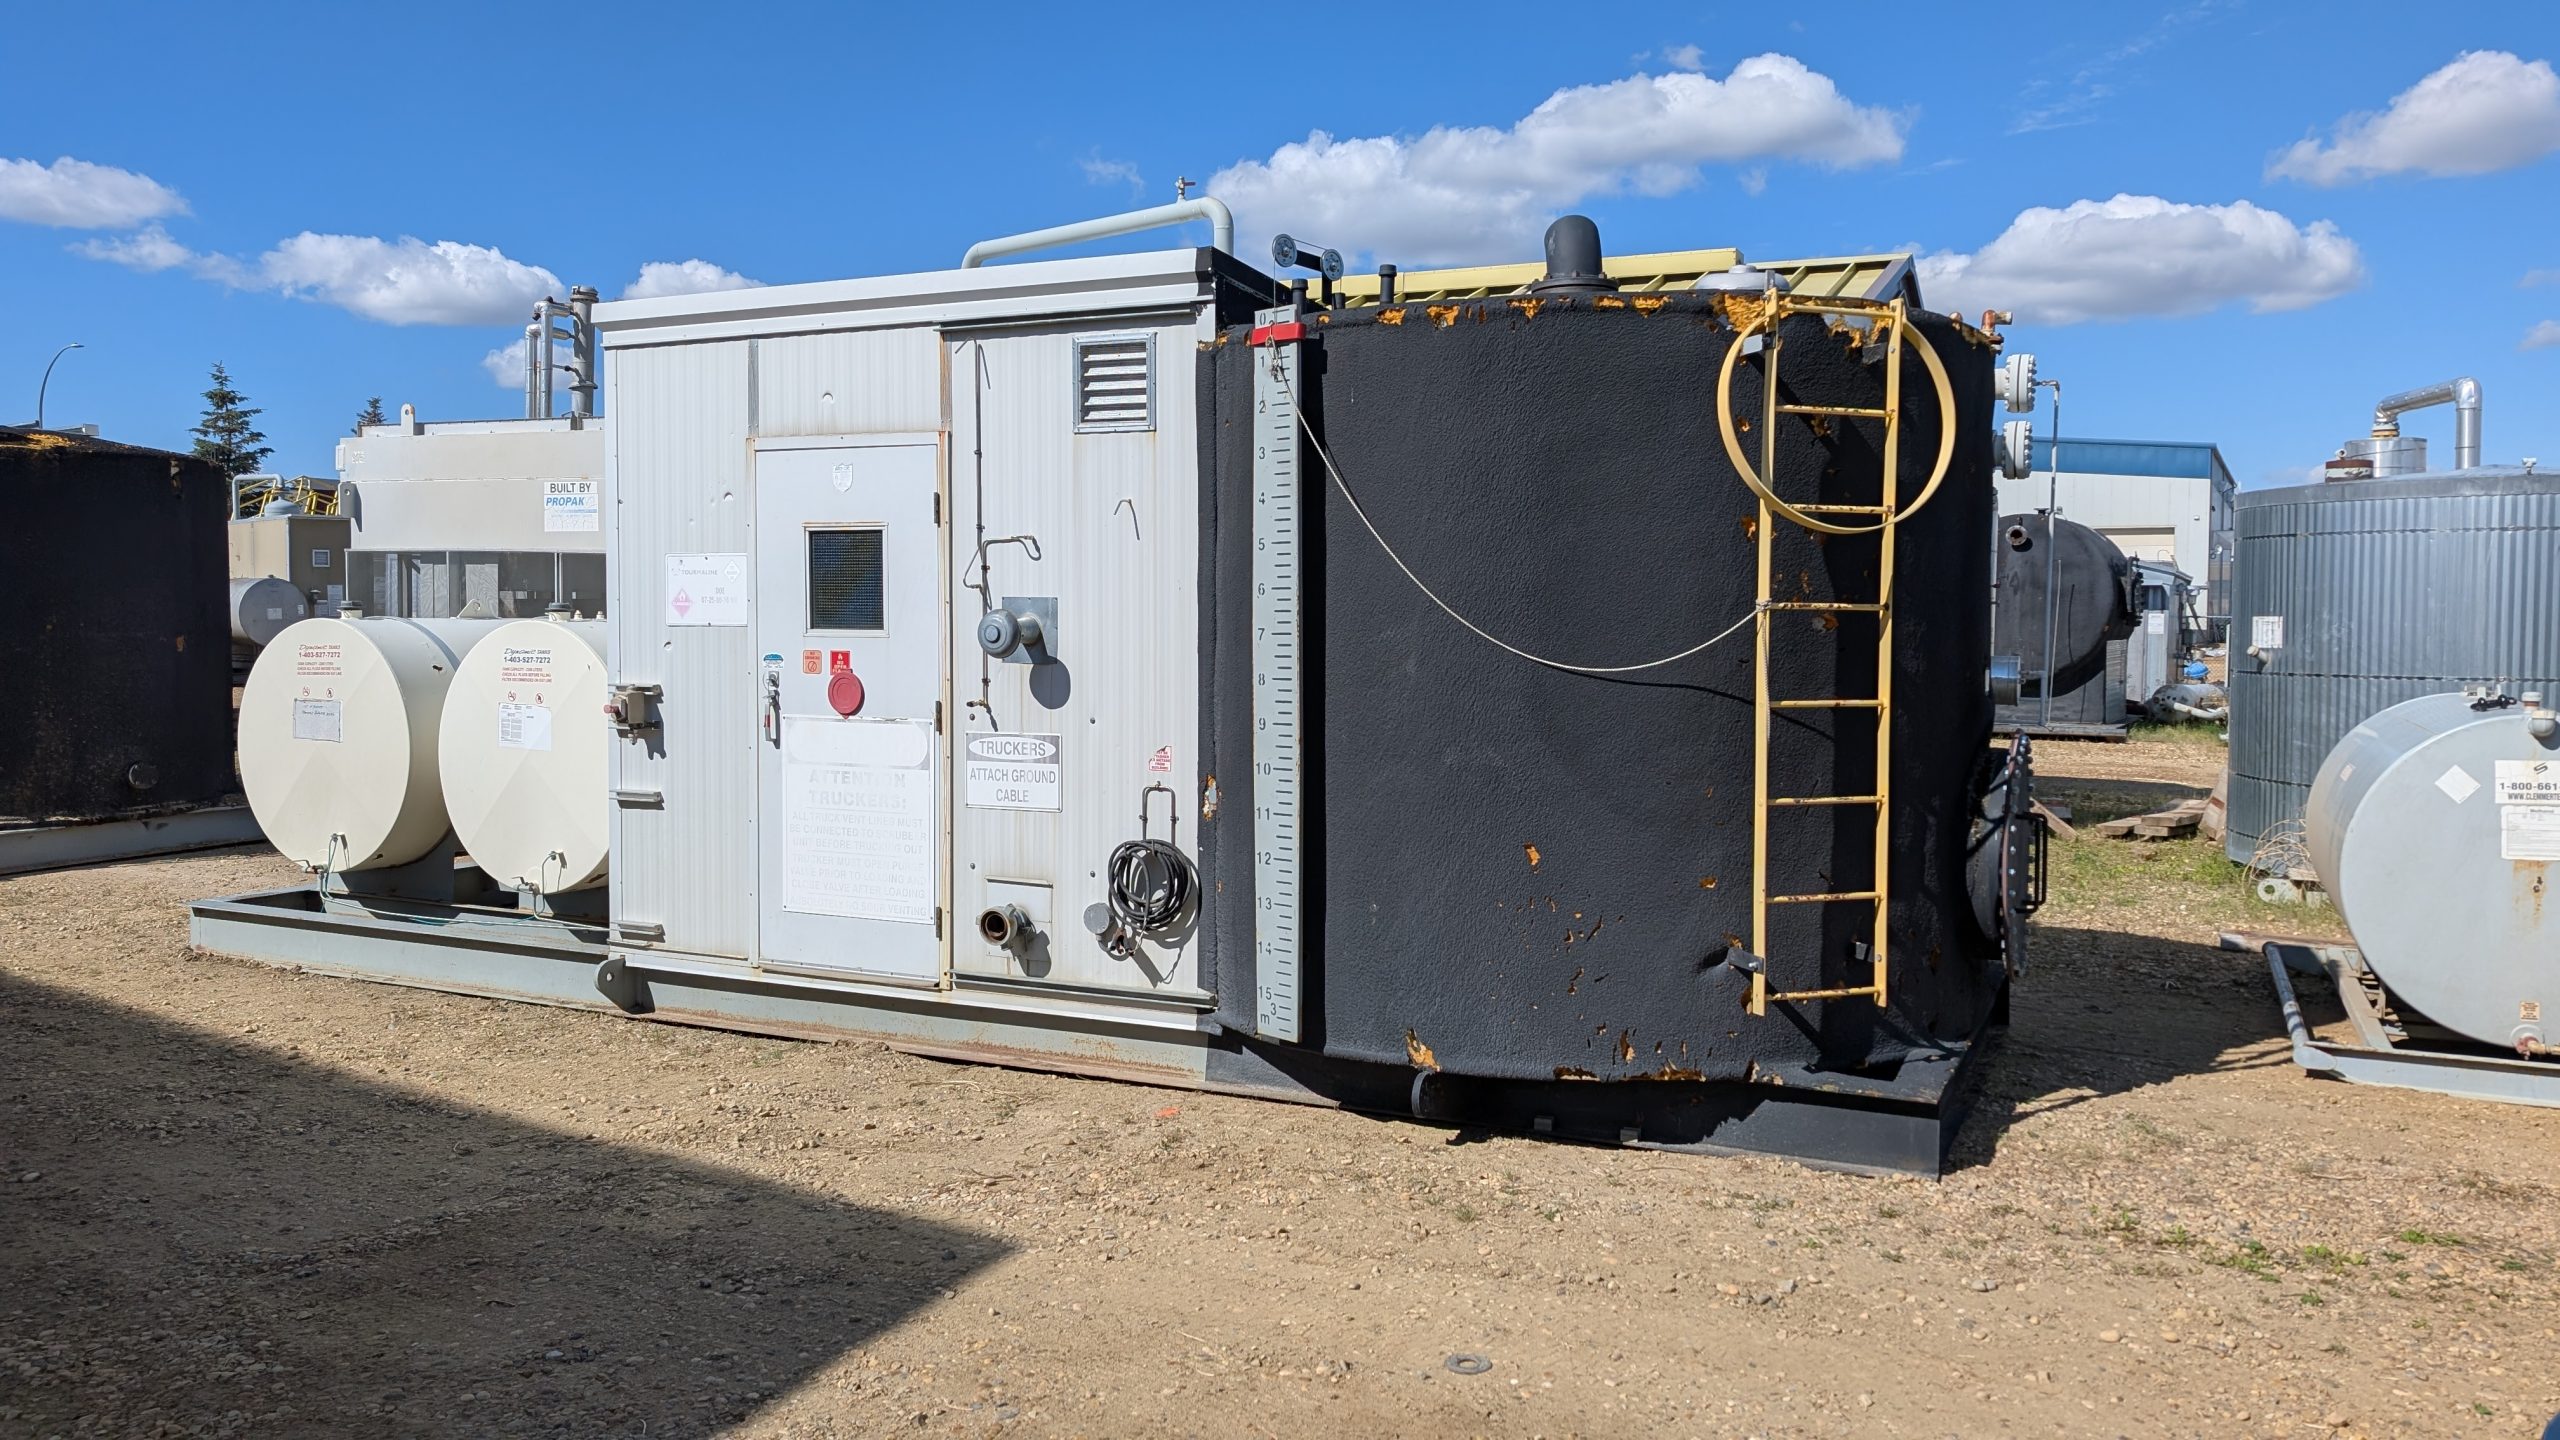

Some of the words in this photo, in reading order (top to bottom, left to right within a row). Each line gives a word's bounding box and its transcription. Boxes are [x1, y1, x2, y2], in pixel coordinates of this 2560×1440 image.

[1260, 312, 1266, 325] 0
[1260, 355, 1265, 368] 1
[1259, 401, 1267, 414] 2
[1259, 446, 1266, 460] 3
[550, 483, 576, 493] BUILT
[579, 482, 592, 493] BY
[546, 497, 585, 507] PROPAK
[1259, 491, 1266, 505] 4
[1259, 537, 1266, 550] 5
[1258, 583, 1266, 596] 6
[1258, 628, 1266, 641] 7
[504, 648, 536, 656] Dynamic
[504, 656, 551, 664] 1-403-527-7272
[1259, 673, 1266, 686] 8
[1259, 718, 1266, 731] 9
[979, 741, 1046, 757] TRUCKERS
[1256, 763, 1271, 775] 10
[970, 768, 1008, 782] ATTACH
[1011, 769, 1056, 784] GROUND
[2500, 782, 2560, 791] 1-800-661
[996, 788, 1029, 803] CABLE
[793, 811, 808, 821] ALL
[842, 813, 866, 825] VENT
[897, 817, 923, 829] MUST
[1256, 807, 1271, 820] 11
[790, 823, 801, 833] BE
[803, 824, 859, 837] CONNECTED
[861, 828, 874, 839] TO
[816, 838, 851, 850] BEFORE
[904, 844, 923, 855] OUT
[1257, 852, 1271, 865] 12
[849, 871, 861, 882] TO
[884, 886, 926, 899] LOADING
[1257, 896, 1272, 910] 13
[887, 904, 927, 917] VENTING
[1258, 941, 1272, 955] 14
[1259, 986, 1272, 1000] 15
